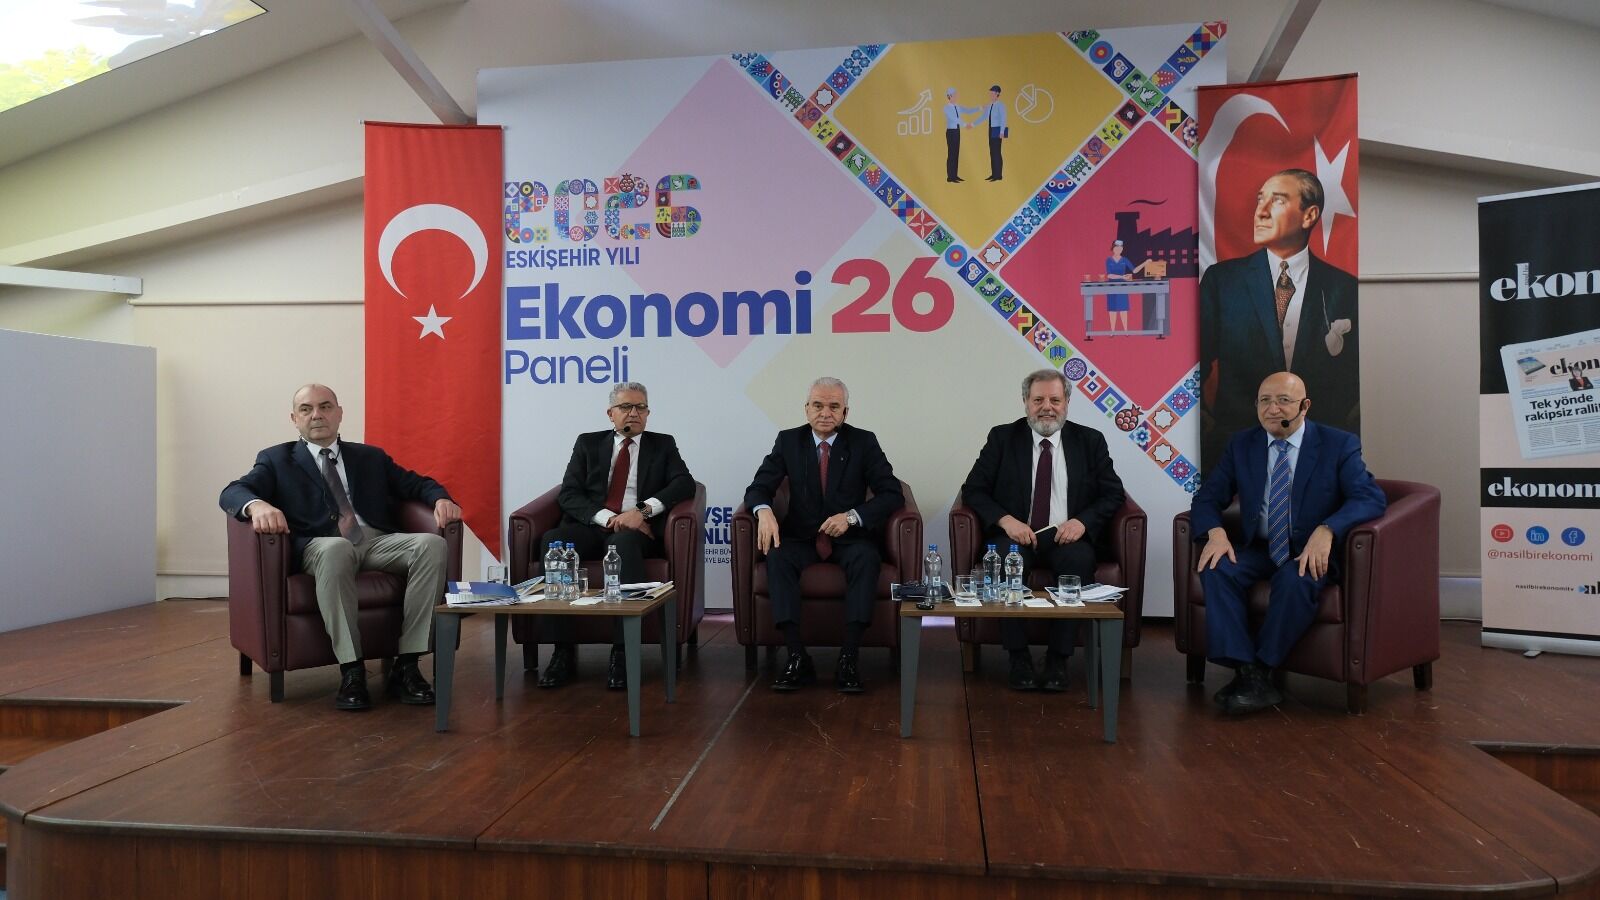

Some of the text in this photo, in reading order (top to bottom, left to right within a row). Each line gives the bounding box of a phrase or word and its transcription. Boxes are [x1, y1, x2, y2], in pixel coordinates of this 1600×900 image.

[504, 173, 702, 244] 2026
[506, 243, 640, 271] ESKİŞEHİR YILI
[506, 256, 955, 341] Ekonomi 26
[505, 345, 629, 385] Paneli
[1525, 408, 1573, 422] rakipsiz
[1529, 398, 1552, 410] Tek
[1554, 393, 1594, 409] yönde
[1487, 549, 1593, 562] @nasilbirekonomi
